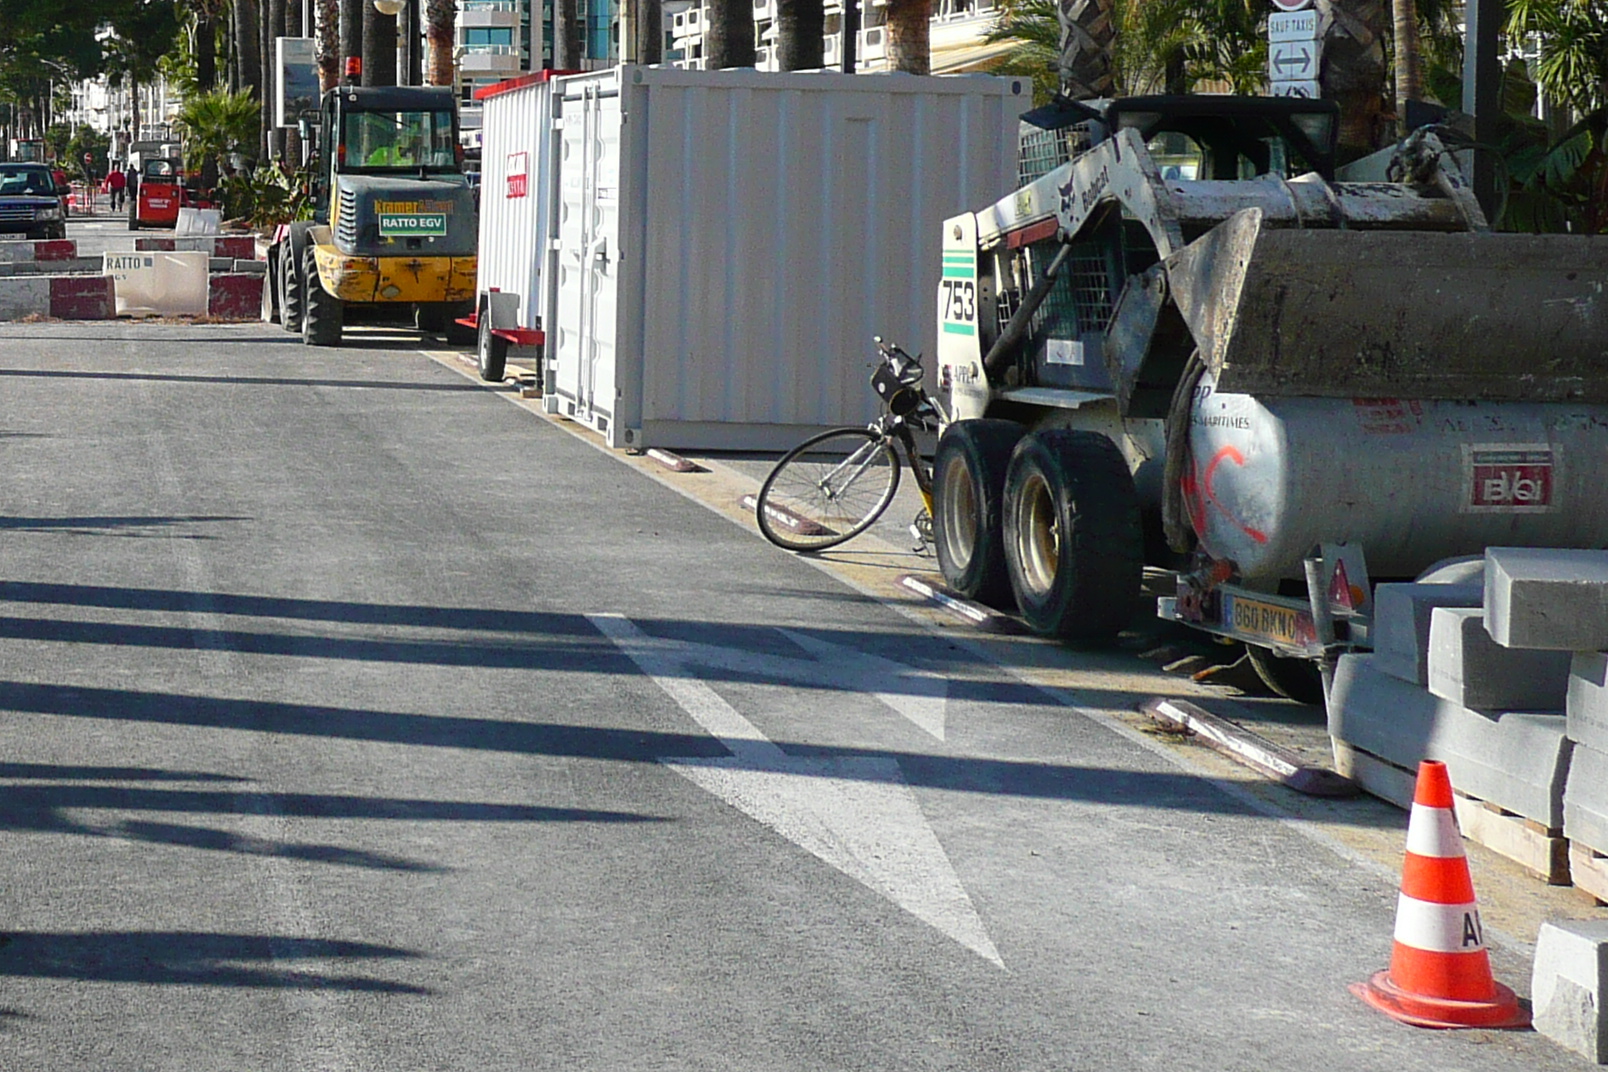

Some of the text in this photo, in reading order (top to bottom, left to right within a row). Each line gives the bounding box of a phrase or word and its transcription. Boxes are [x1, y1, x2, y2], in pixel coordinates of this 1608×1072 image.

[1270, 17, 1315, 34] SAUF TAXIS
[382, 218, 442, 228] RATTO EGV
[106, 257, 141, 270] RATTO
[942, 280, 975, 322] 753
